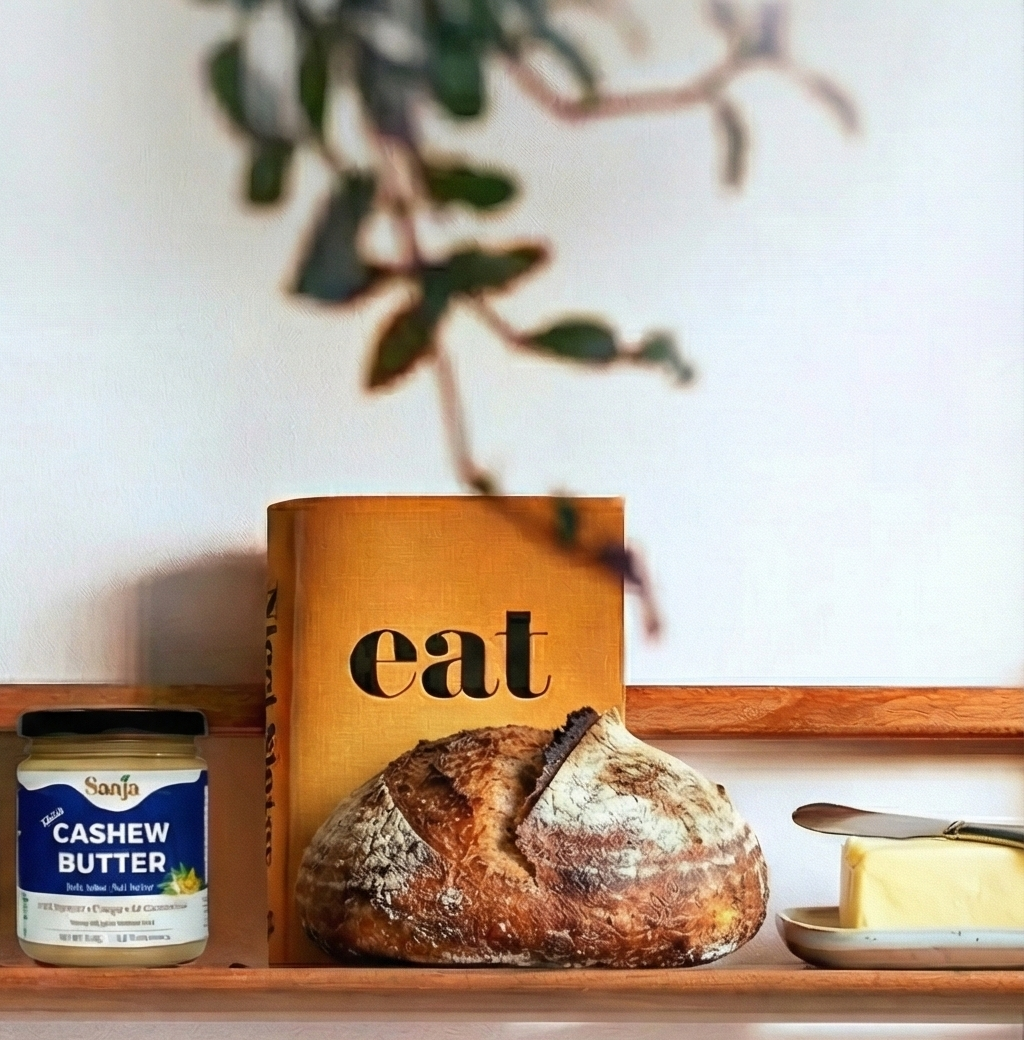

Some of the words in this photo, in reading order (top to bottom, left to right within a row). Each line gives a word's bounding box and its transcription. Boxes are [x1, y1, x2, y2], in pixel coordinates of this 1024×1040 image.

[349, 610, 553, 699] eat
[52, 822, 170, 844] CASHEW
[58, 852, 166, 874] BUTTER
